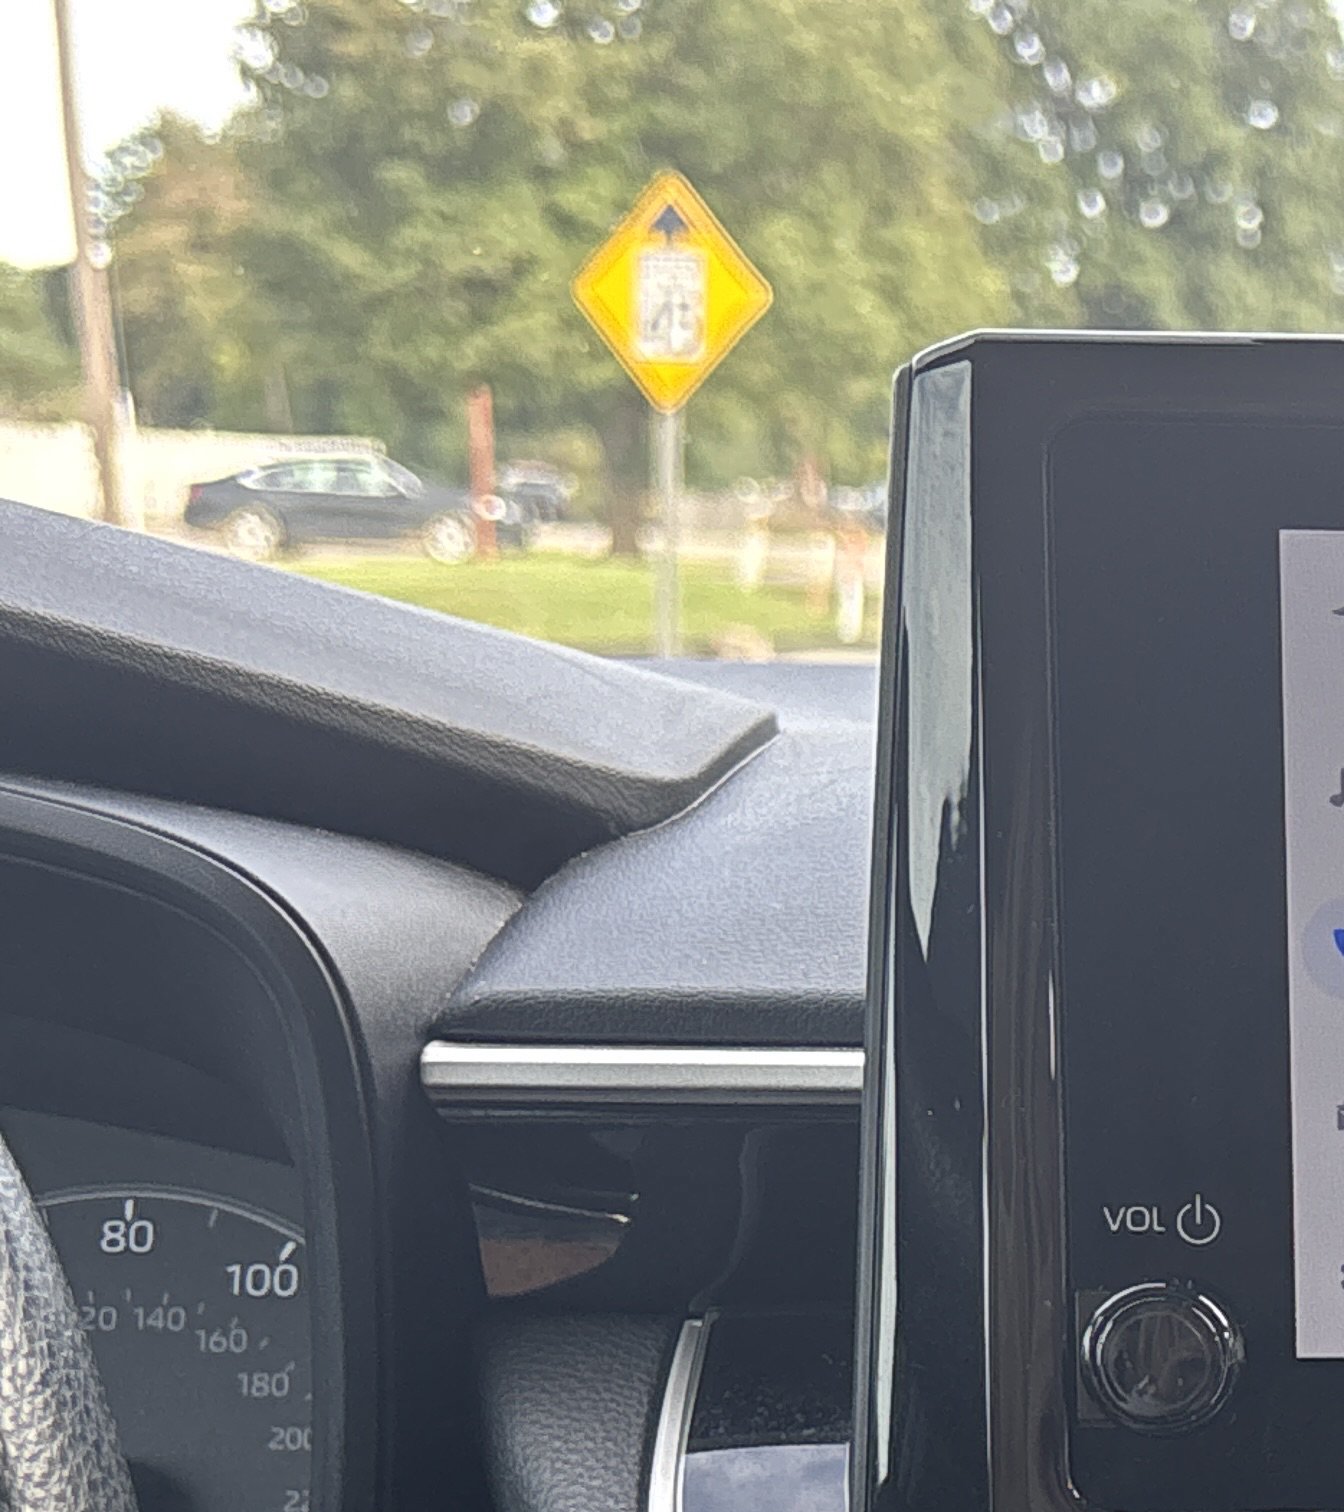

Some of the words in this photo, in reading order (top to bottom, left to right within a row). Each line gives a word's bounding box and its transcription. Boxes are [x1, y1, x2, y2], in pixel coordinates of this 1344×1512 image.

[1103, 1205, 1167, 1233] VOL
[100, 1220, 155, 1254] 80
[226, 1262, 300, 1298] 100
[80, 1305, 118, 1332] 20
[133, 1306, 186, 1333] 140
[197, 1328, 248, 1353] 160
[238, 1371, 289, 1398] 180
